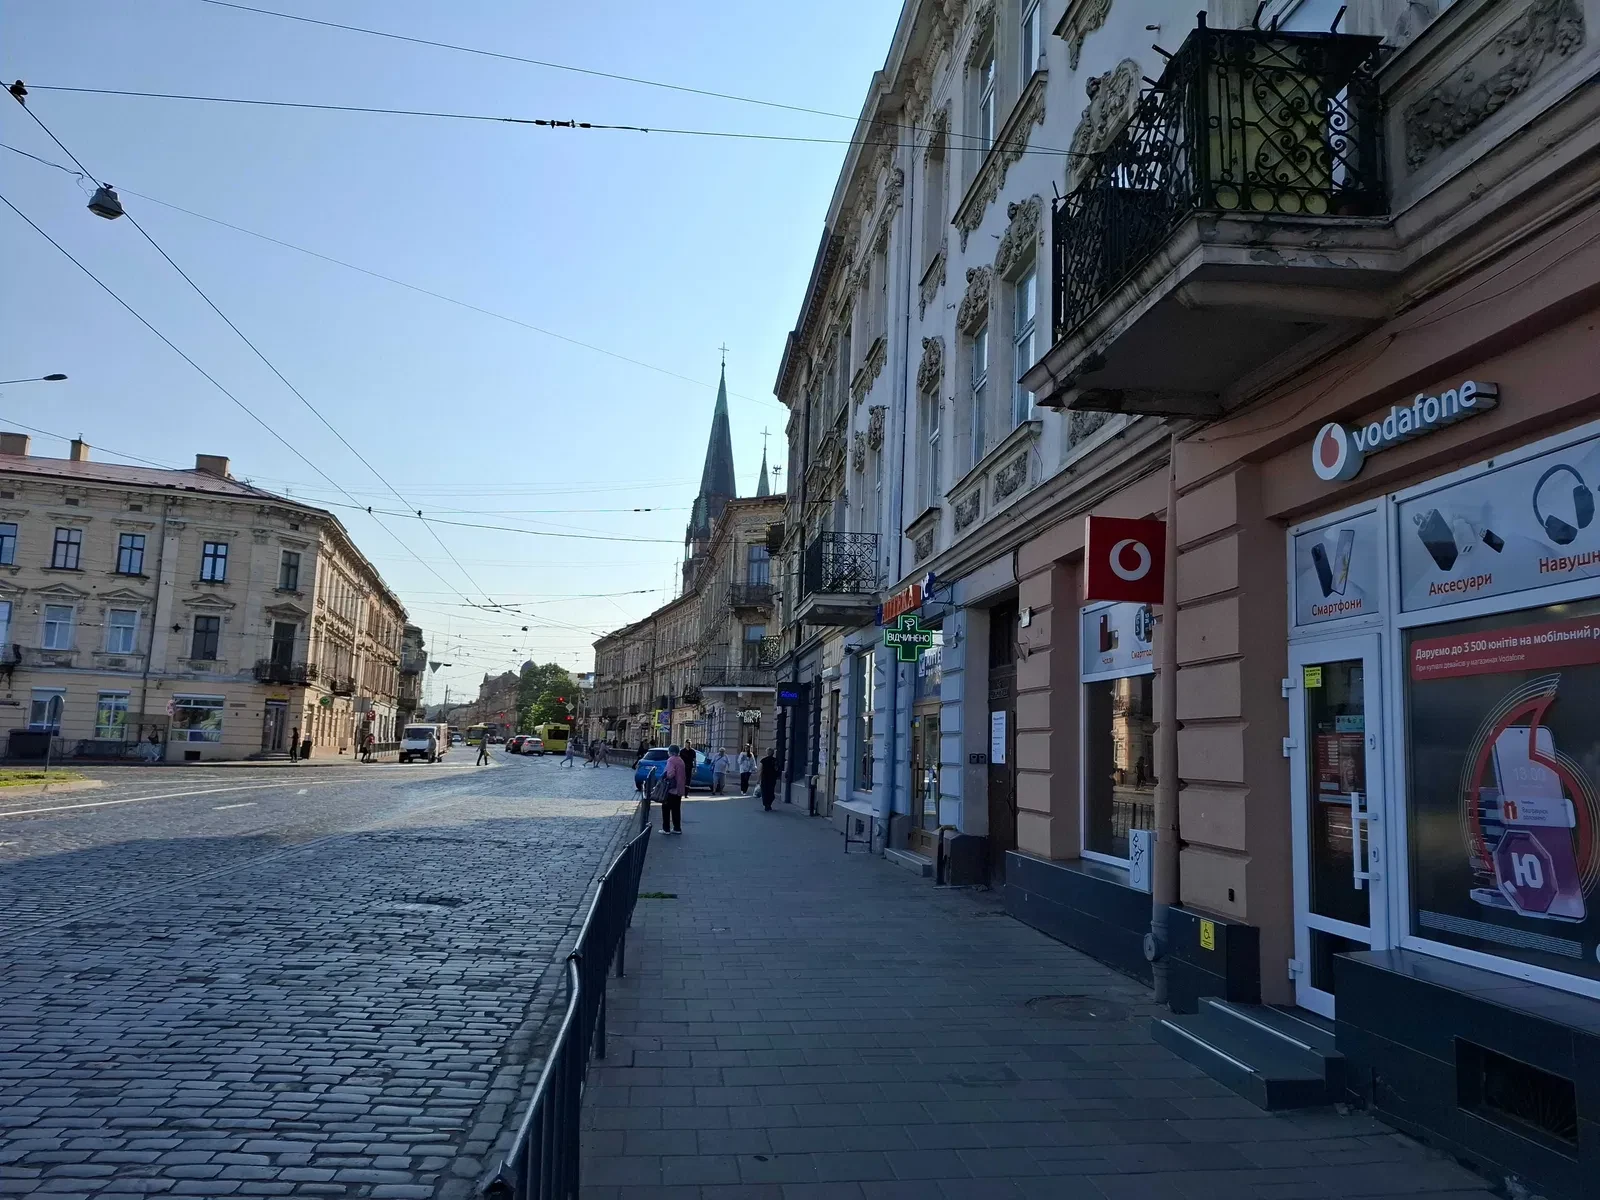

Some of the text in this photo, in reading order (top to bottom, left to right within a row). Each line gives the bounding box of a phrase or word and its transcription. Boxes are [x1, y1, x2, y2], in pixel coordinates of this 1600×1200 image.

[1352, 380, 1477, 452] vodafone
[1429, 572, 1492, 596] Аксесуари
[1311, 598, 1362, 617] Смартфони
[887, 632, 930, 643] ВІДЧИНЕНО
[1415, 647, 1450, 661] Даруємо
[1451, 645, 1463, 655] до
[1463, 642, 1470, 653] 3
[1470, 639, 1487, 652] 500
[1488, 636, 1518, 650] юнітів
[1519, 636, 1531, 646] на
[1533, 625, 1591, 644] мобільний
[1510, 851, 1544, 889] Ю
